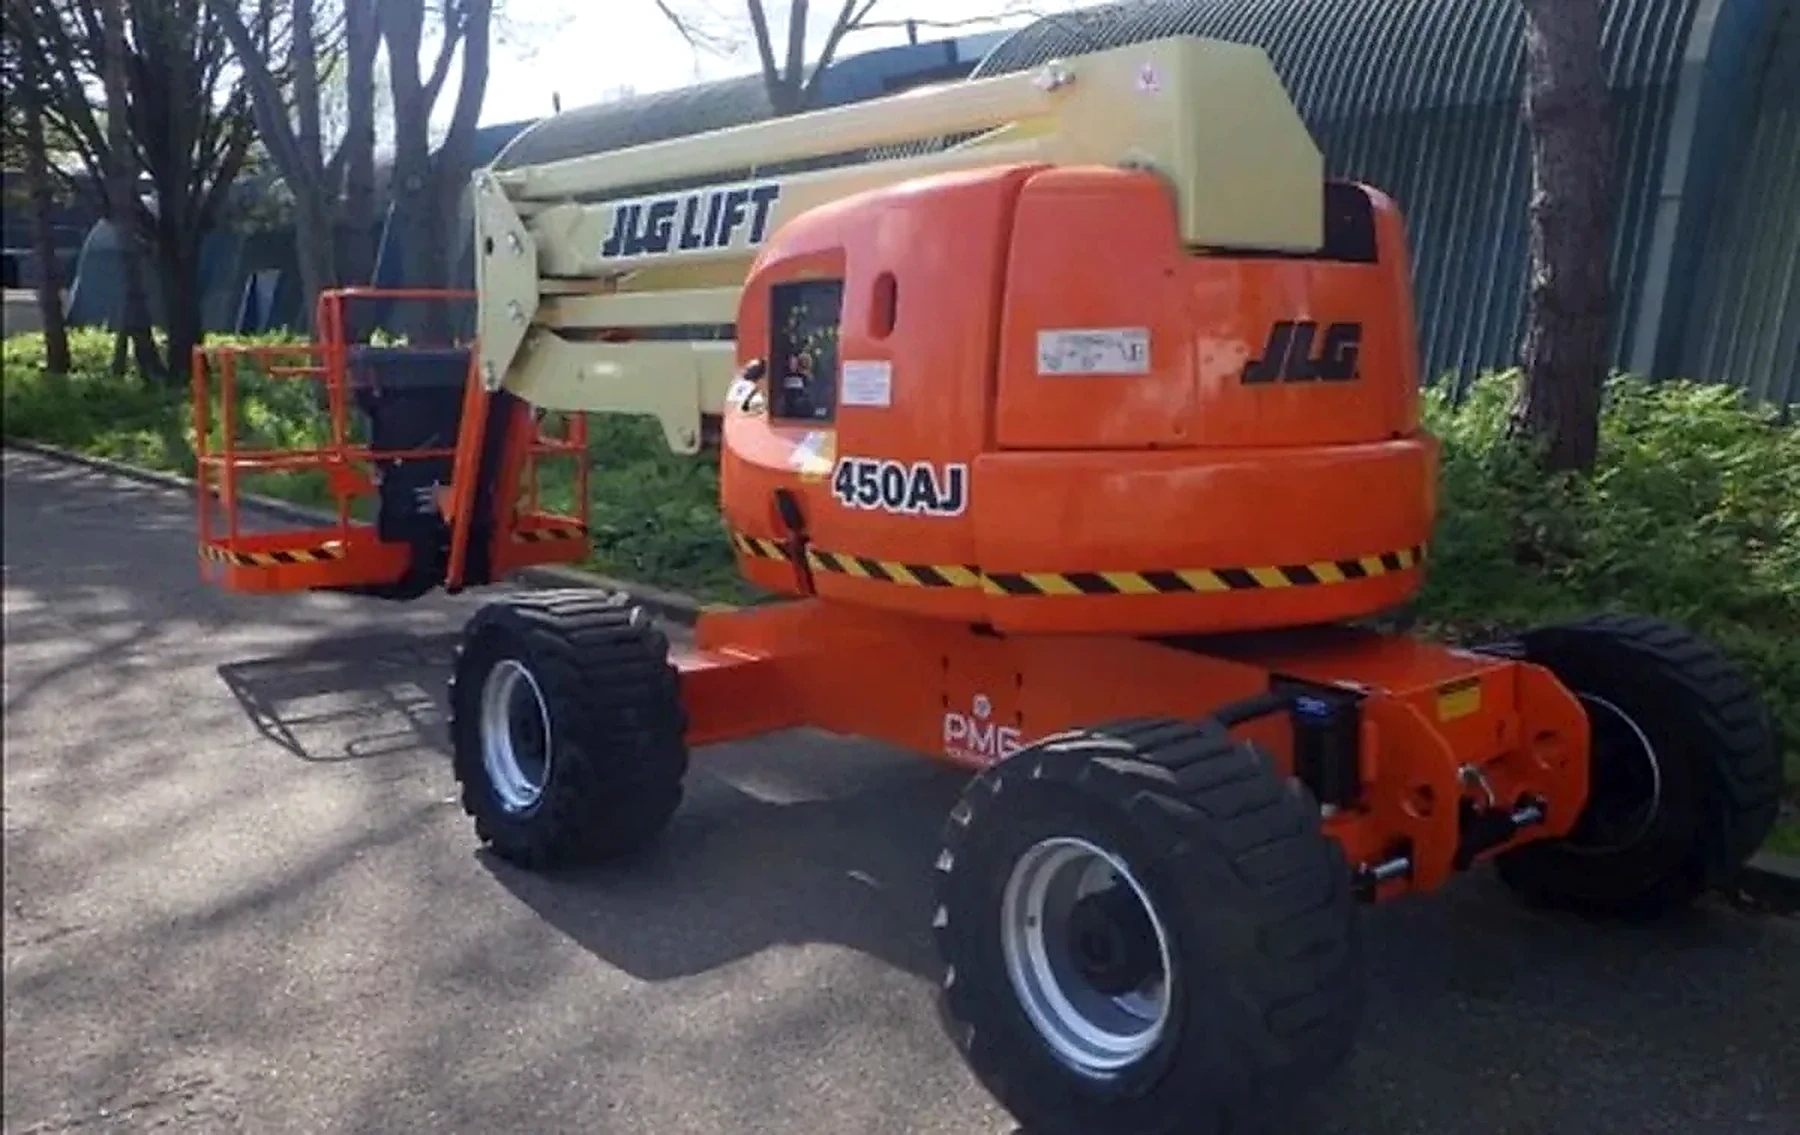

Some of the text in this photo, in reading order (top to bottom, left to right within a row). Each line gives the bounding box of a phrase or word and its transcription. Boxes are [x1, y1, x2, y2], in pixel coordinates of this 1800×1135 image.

[602, 184, 780, 257] JLG LIFT
[1240, 321, 1363, 384] JLG
[833, 458, 966, 514] 450AJ
